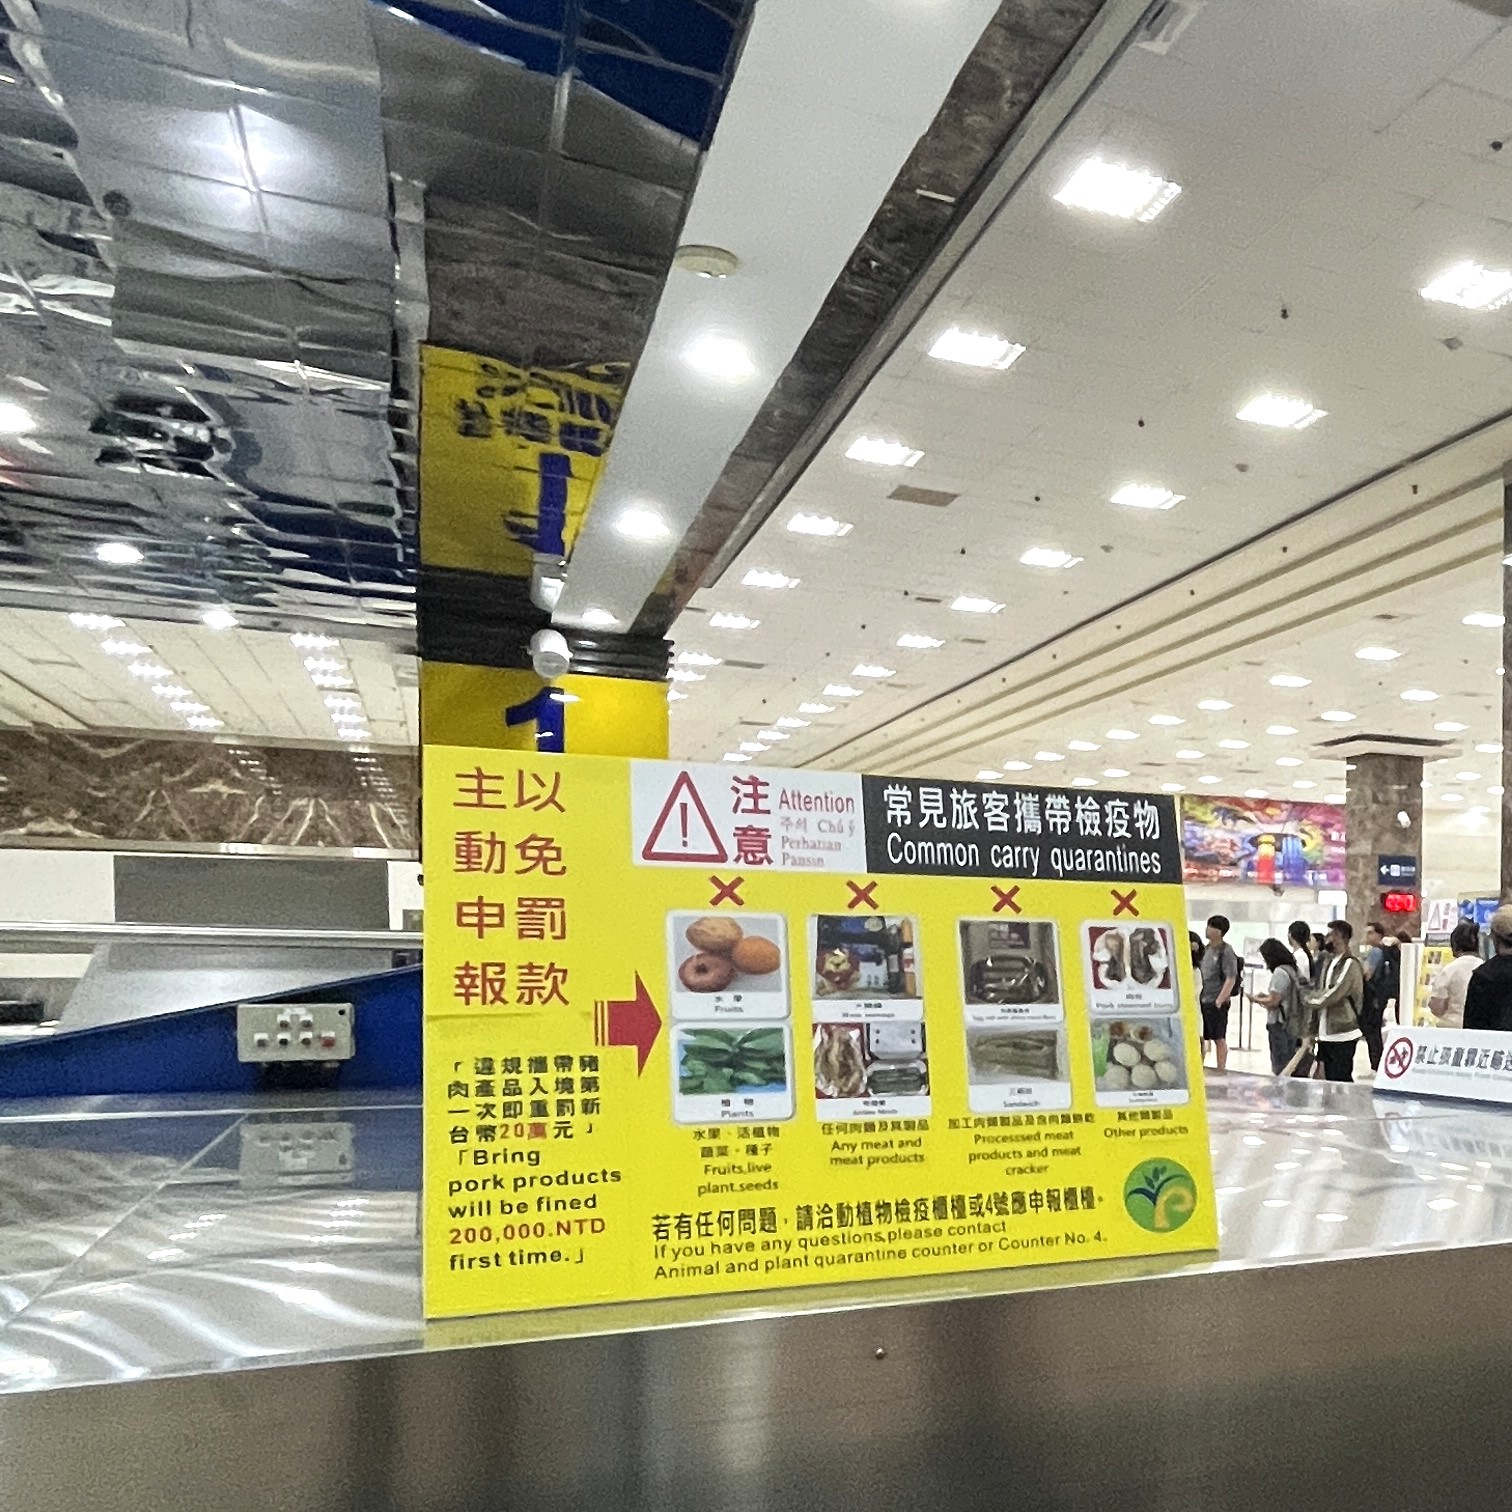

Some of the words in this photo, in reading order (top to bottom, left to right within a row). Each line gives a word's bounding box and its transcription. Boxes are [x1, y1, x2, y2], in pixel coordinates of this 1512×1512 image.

[779, 787, 856, 814] Attention
[883, 784, 1161, 841] 常見旅客攜帶檢疫物
[730, 774, 774, 866] 注意
[886, 833, 979, 868] Common
[990, 845, 1041, 877] carry
[1051, 842, 1162, 878] quarantines
[453, 766, 509, 1006] 主動申報
[513, 769, 570, 1006] 以免罰款
[831, 1140, 858, 1154] Any
[861, 1139, 894, 1151] meat
[898, 1136, 922, 1149] and
[1044, 1130, 1074, 1141] meat
[1103, 1127, 1136, 1138] Other
[1139, 1124, 1189, 1140] products
[830, 1155, 863, 1166] meat
[866, 1152, 925, 1170] products
[968, 1148, 1023, 1165] products
[1026, 1146, 1049, 1158] and
[1052, 1145, 1082, 1157] meat
[448, 1174, 505, 1197] pork
[513, 1169, 622, 1193] products
[1005, 1163, 1050, 1177] cracker
[448, 1200, 492, 1219] will
[500, 1200, 529, 1215] be
[536, 1193, 597, 1212] fined
[654, 1243, 668, 1259] If
[671, 1244, 705, 1261] you
[710, 1240, 755, 1256] have
[761, 1239, 793, 1253] any
[947, 1220, 1007, 1237] contact
[449, 1252, 502, 1271] first
[654, 1260, 720, 1280] Animal
[725, 1258, 759, 1275] and
[764, 1254, 809, 1274] plant
[814, 1247, 907, 1268] quarantine
[911, 1240, 973, 1260] counter
[978, 1241, 994, 1252] or
[998, 1235, 1060, 1251] Counter
[1064, 1232, 1090, 1246] No.
